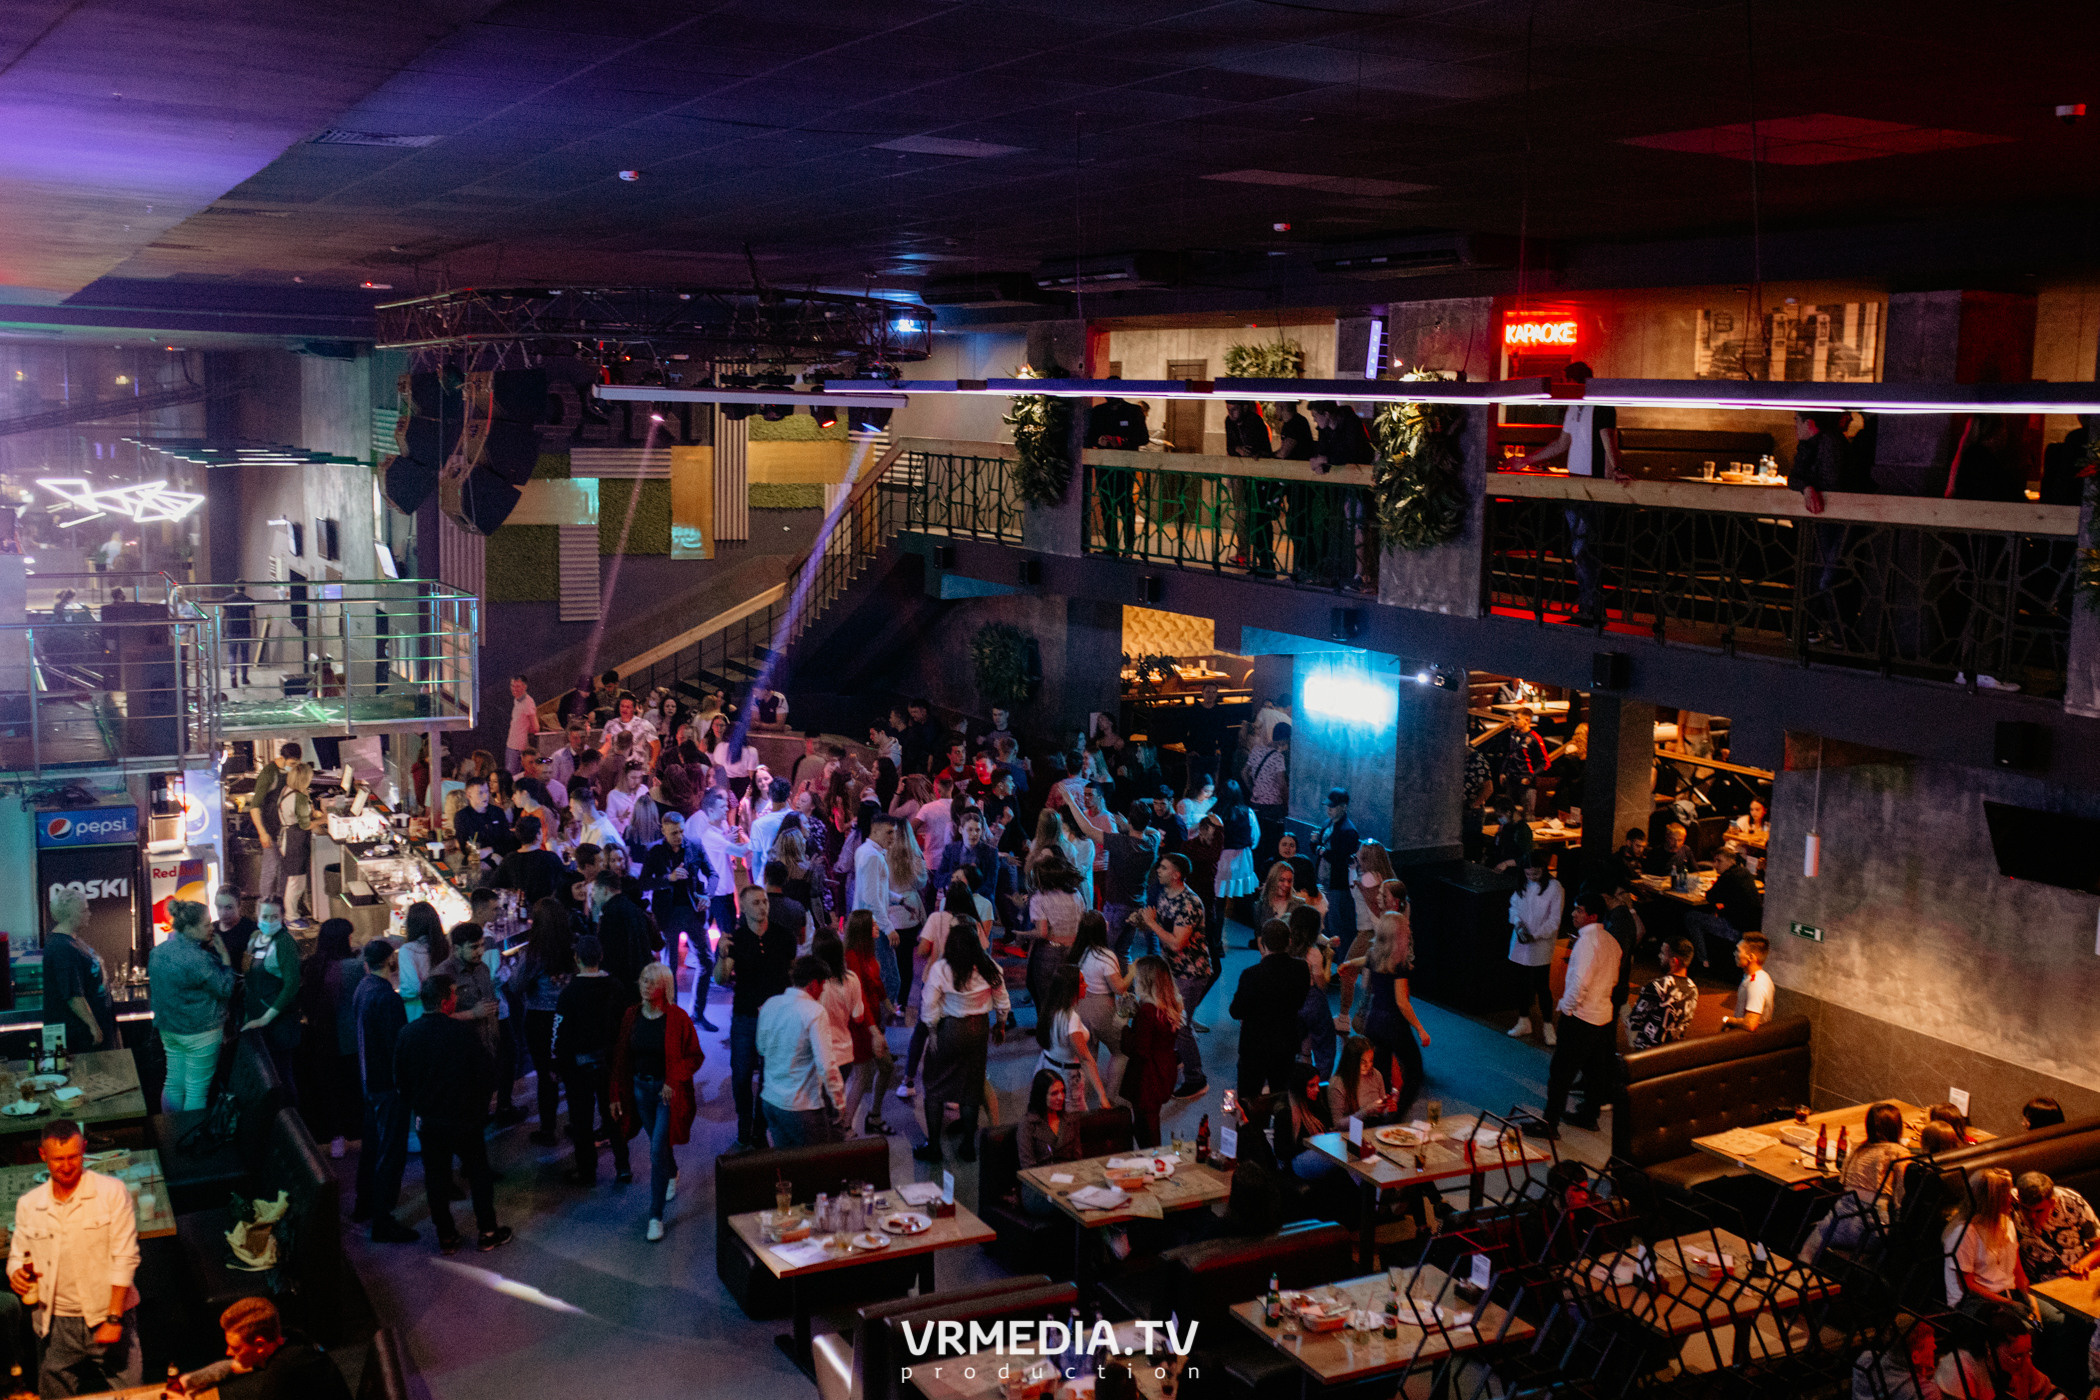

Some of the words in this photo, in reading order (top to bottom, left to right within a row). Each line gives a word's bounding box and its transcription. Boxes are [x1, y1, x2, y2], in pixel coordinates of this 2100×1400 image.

[1505, 322, 1577, 343] КАРАОКЕ
[76, 817, 127, 836] pepsi
[152, 866, 177, 878] Red
